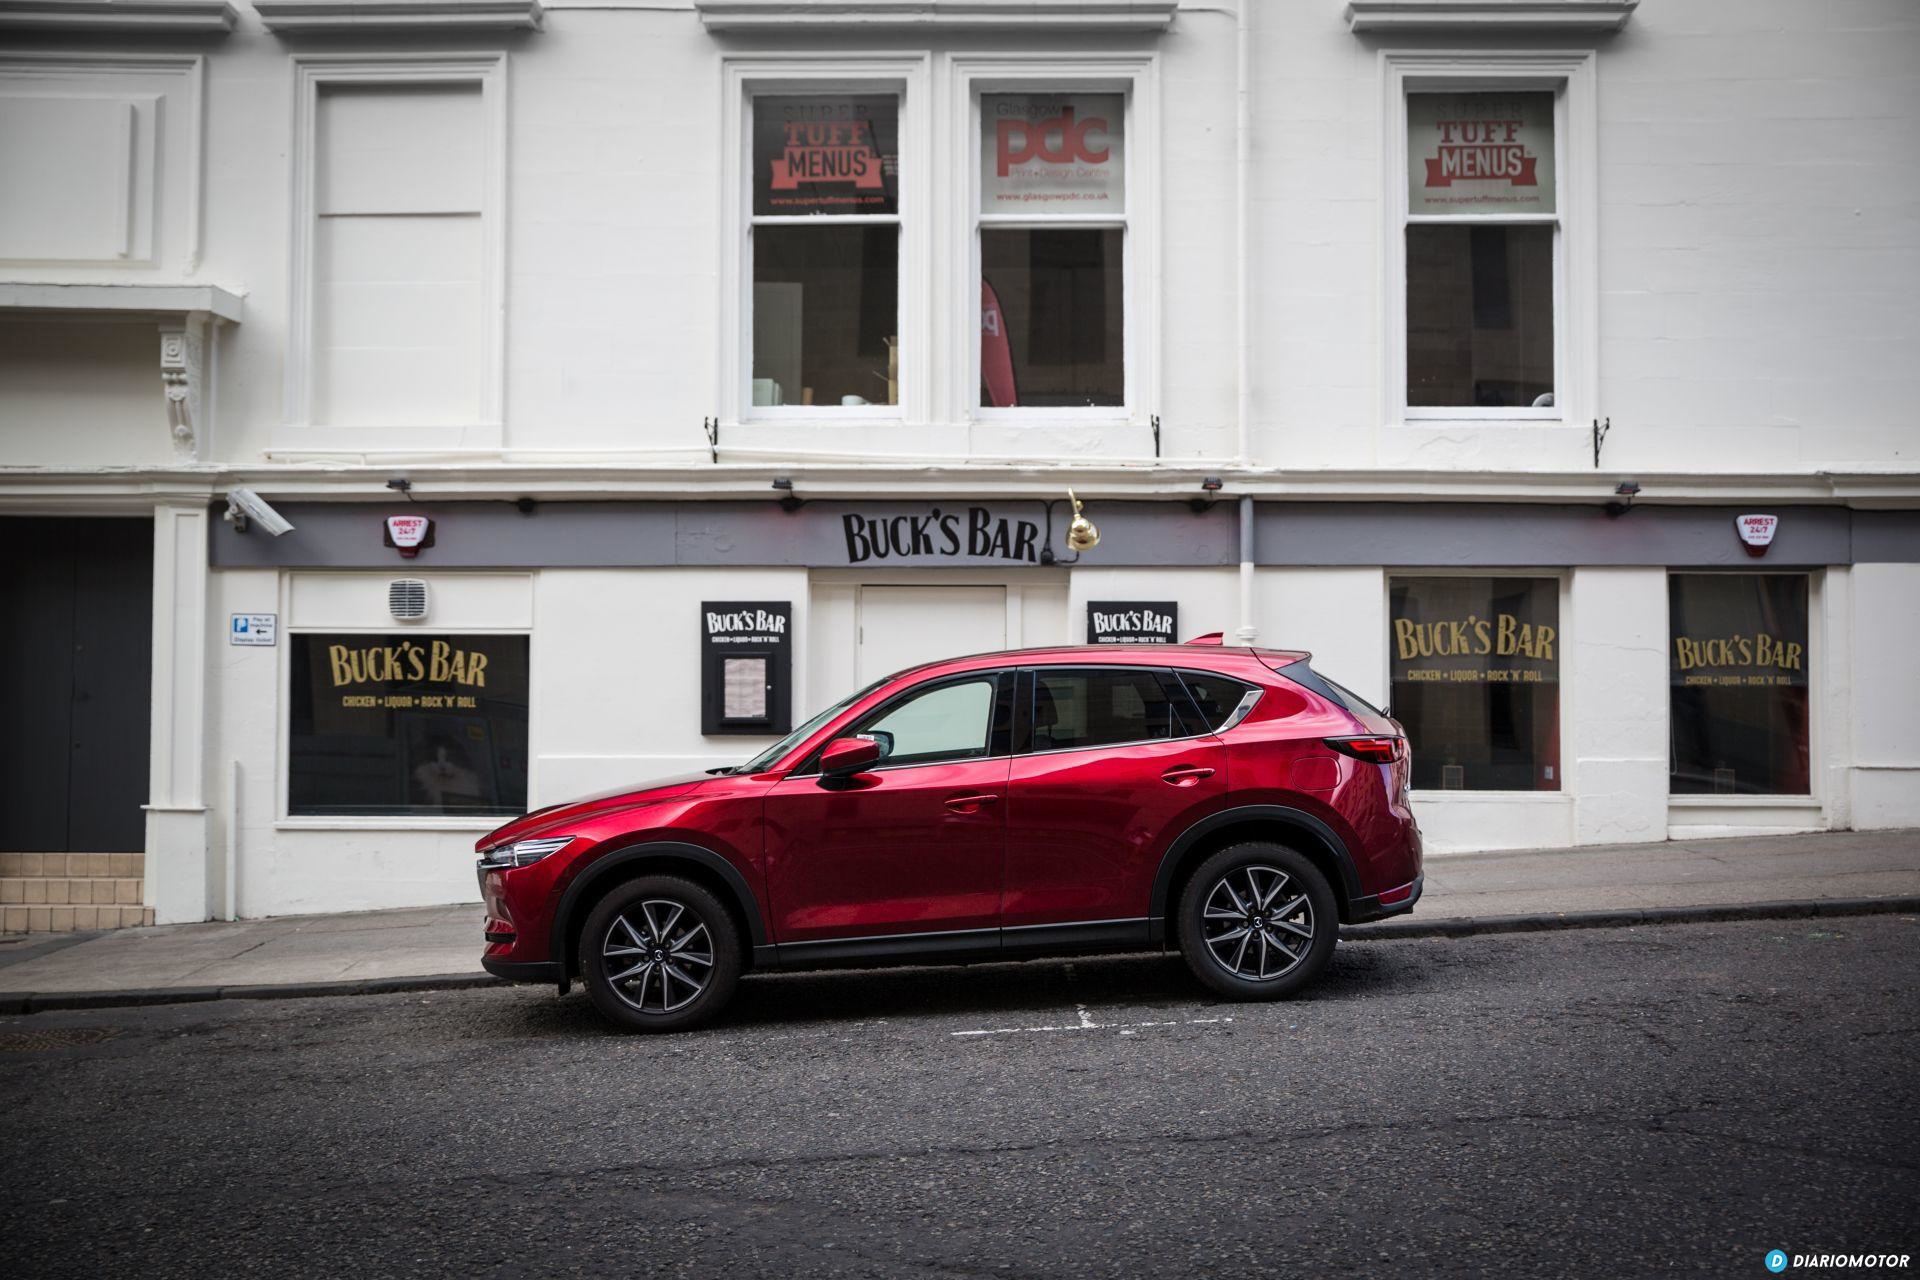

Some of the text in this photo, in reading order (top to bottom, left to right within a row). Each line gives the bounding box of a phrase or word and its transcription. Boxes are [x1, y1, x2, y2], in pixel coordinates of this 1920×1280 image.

[783, 121, 869, 145] TUFF
[996, 106, 1109, 177] pdc
[1436, 120, 1524, 143] TUFF
[788, 149, 867, 177] MENUS
[1441, 148, 1522, 177] MENUS
[393, 519, 423, 527] ARREST
[842, 506, 1039, 563] BUCK'S BAR
[706, 609, 786, 634] BUCK'S BAR
[1093, 609, 1173, 634] BUCK'S BAR
[1394, 614, 1555, 661] BUCK'S BAR
[1676, 633, 1802, 670] BUCK'S BAR
[329, 640, 488, 687] BUCK'S BAR
[1407, 670, 1441, 682] CHICKEN
[1450, 670, 1477, 683] LIQUOR
[1487, 670, 1508, 682] ROCK
[1523, 670, 1542, 682] ROLL
